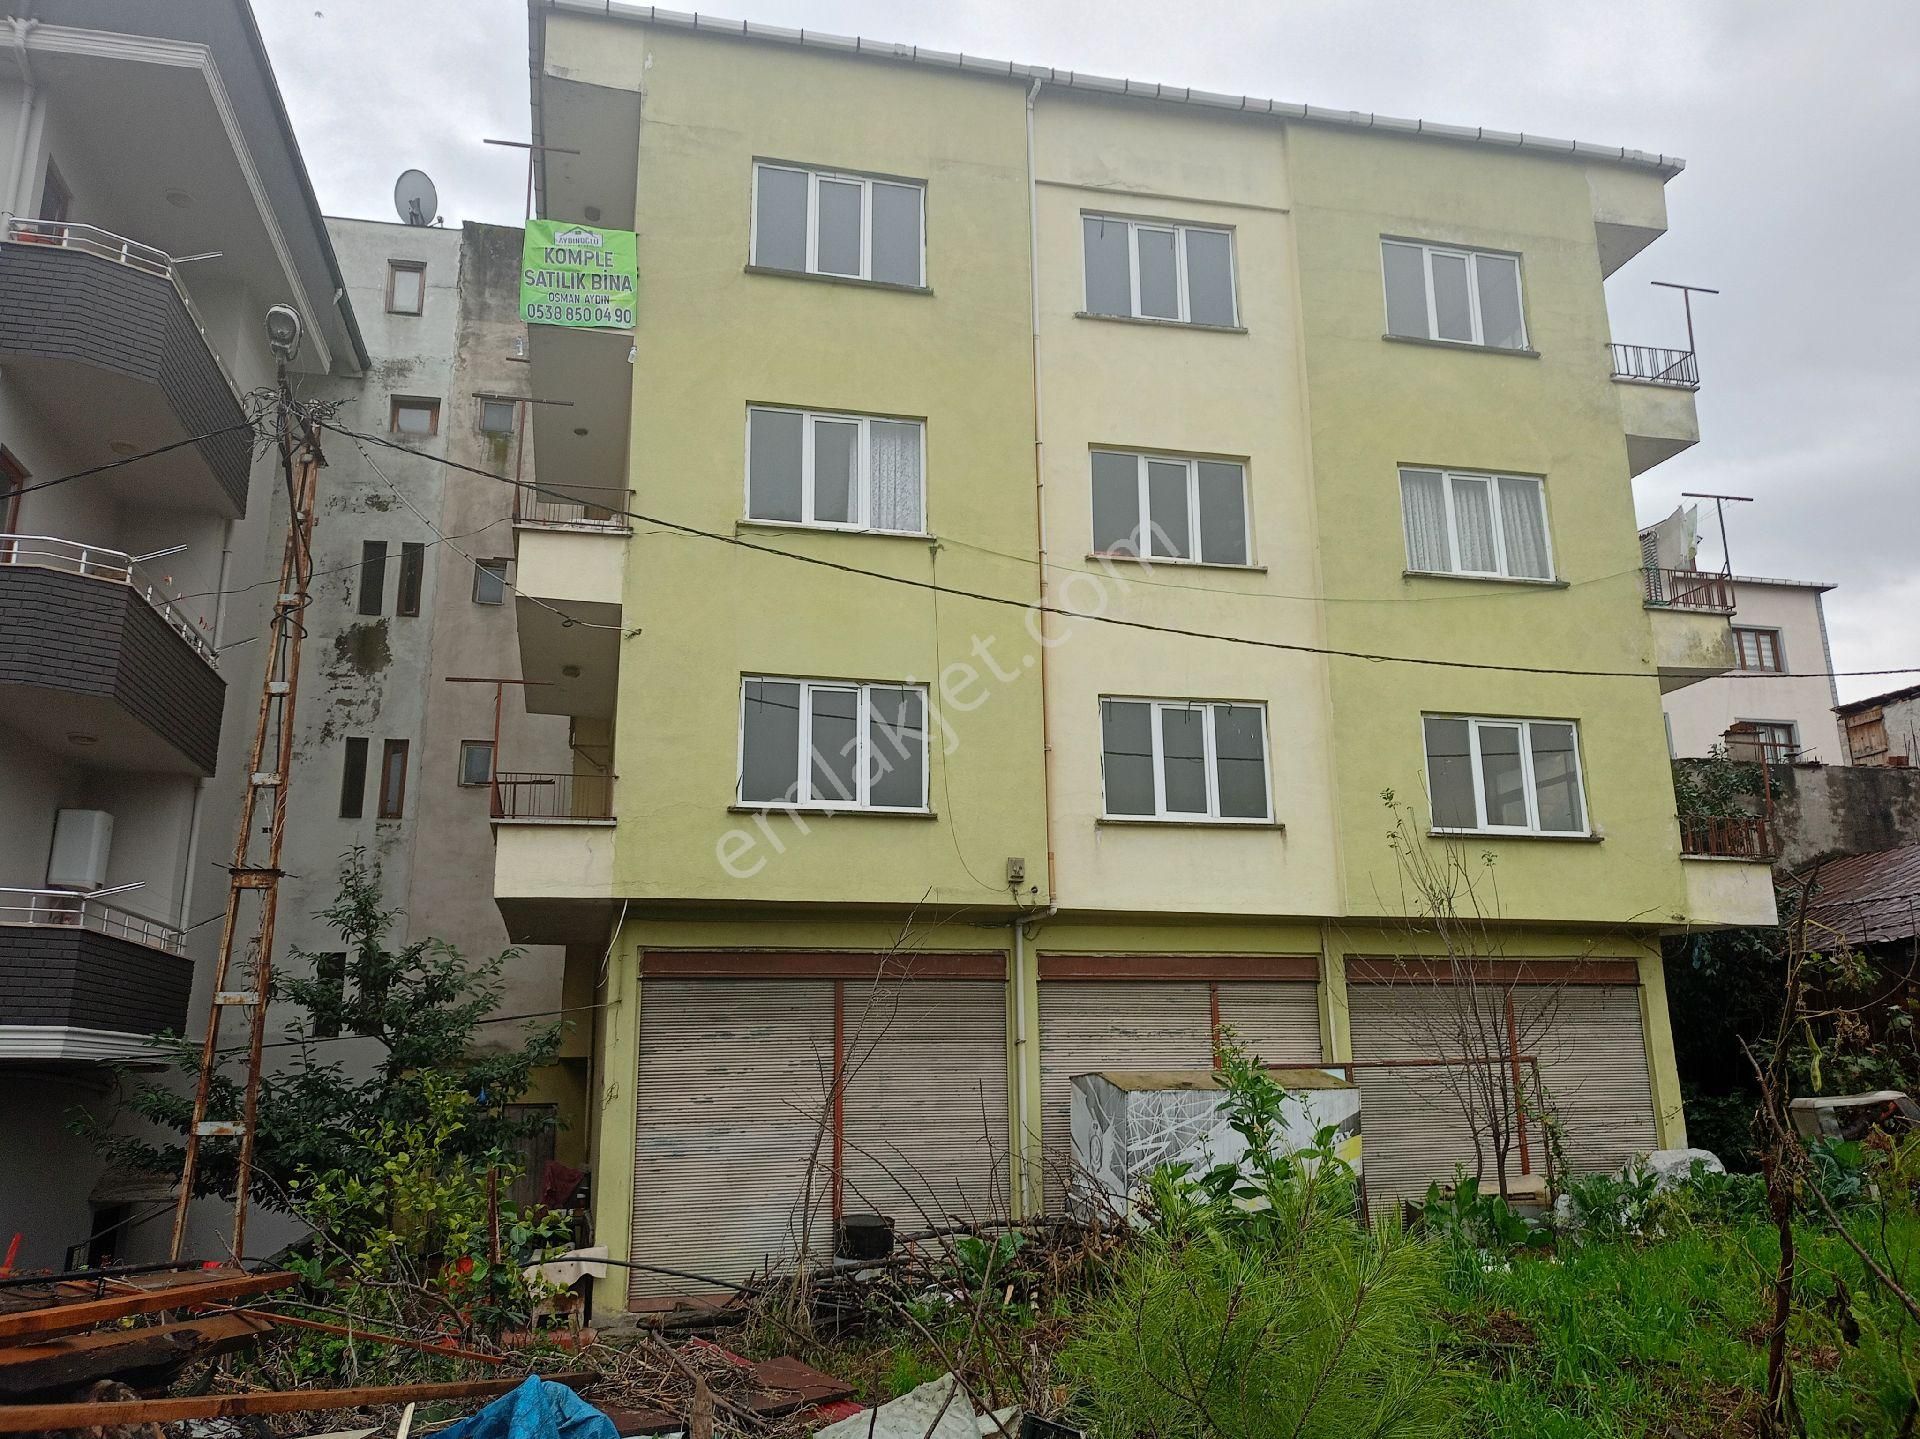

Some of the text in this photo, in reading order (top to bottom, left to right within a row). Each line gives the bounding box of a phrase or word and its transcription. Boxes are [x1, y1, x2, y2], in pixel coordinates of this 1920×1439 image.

[544, 247, 613, 267] KOMPLE
[524, 269, 632, 292] SATILIK BİNA
[548, 292, 610, 304] OSMAN AYDIN
[527, 304, 631, 323] 0538 850 04 90
